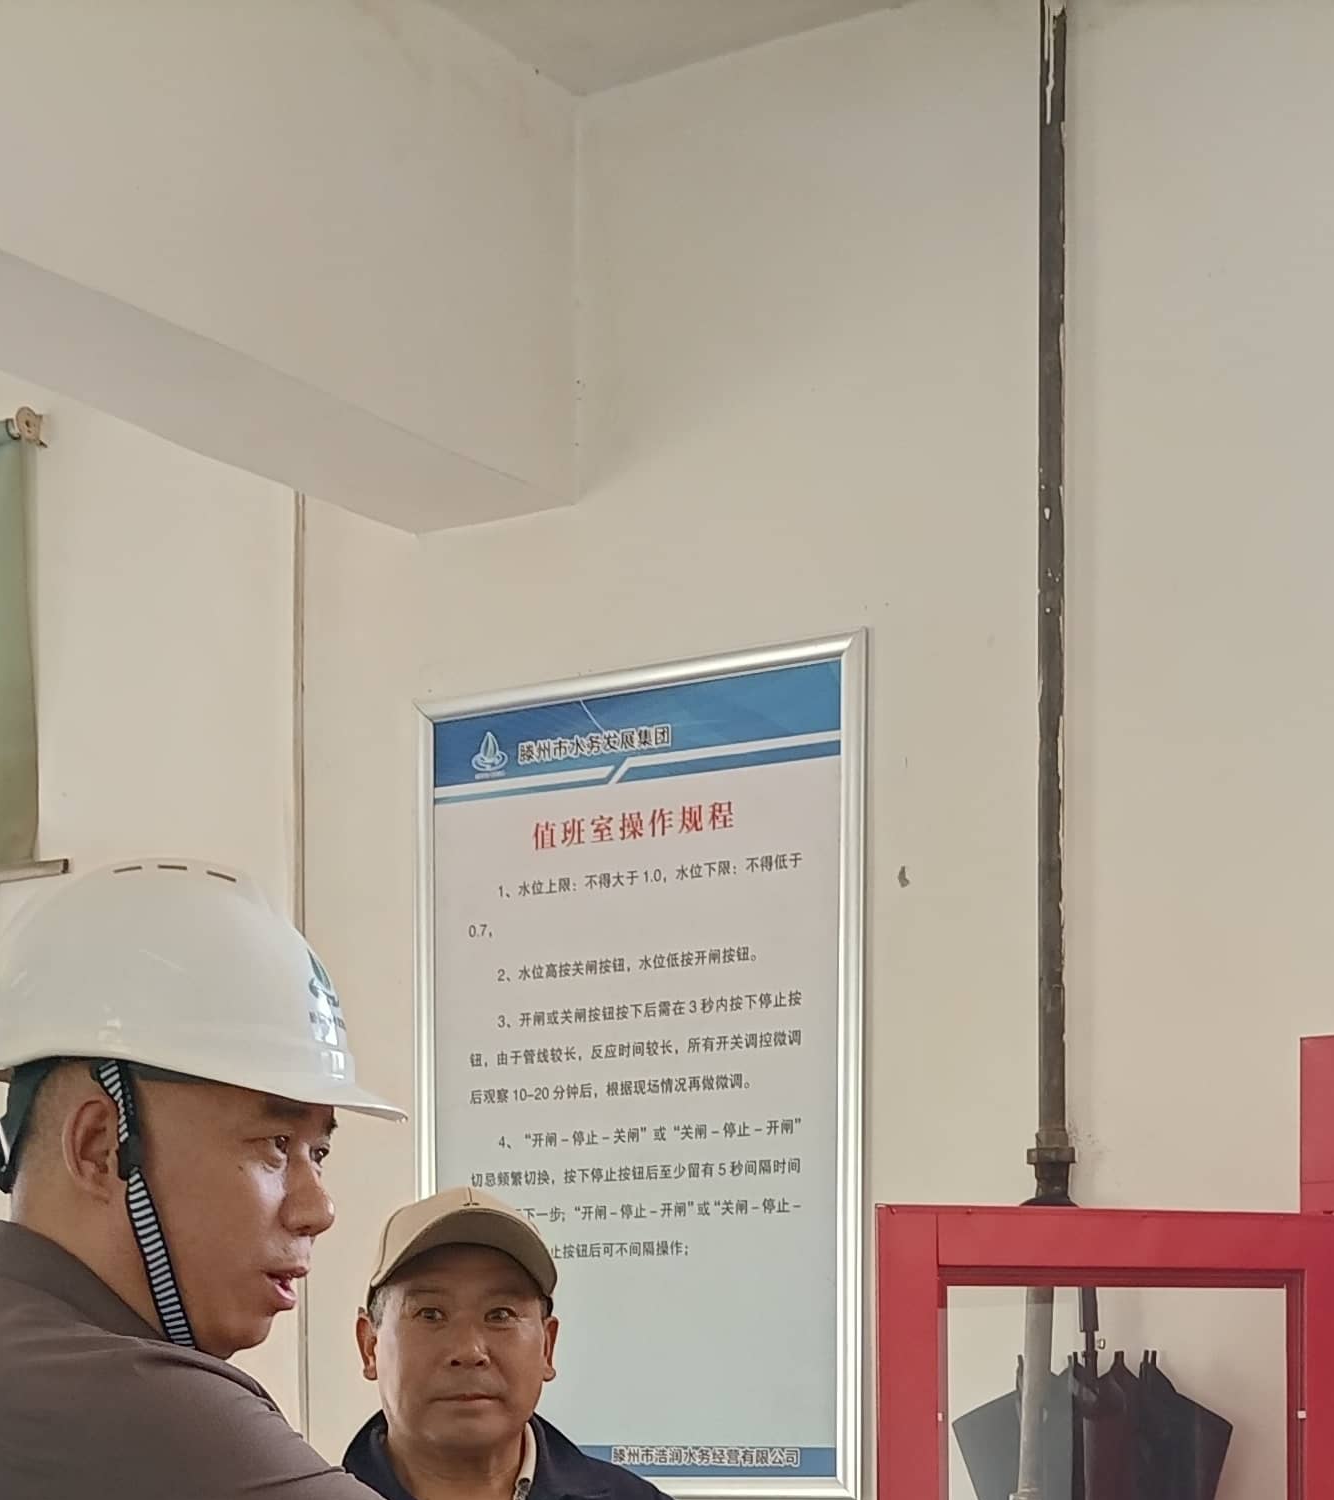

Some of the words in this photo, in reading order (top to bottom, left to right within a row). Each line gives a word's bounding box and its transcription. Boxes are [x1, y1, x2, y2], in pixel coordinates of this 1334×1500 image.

[519, 725, 672, 765] 滕州市水务发展集团
[532, 800, 735, 851] 值班室操作规程
